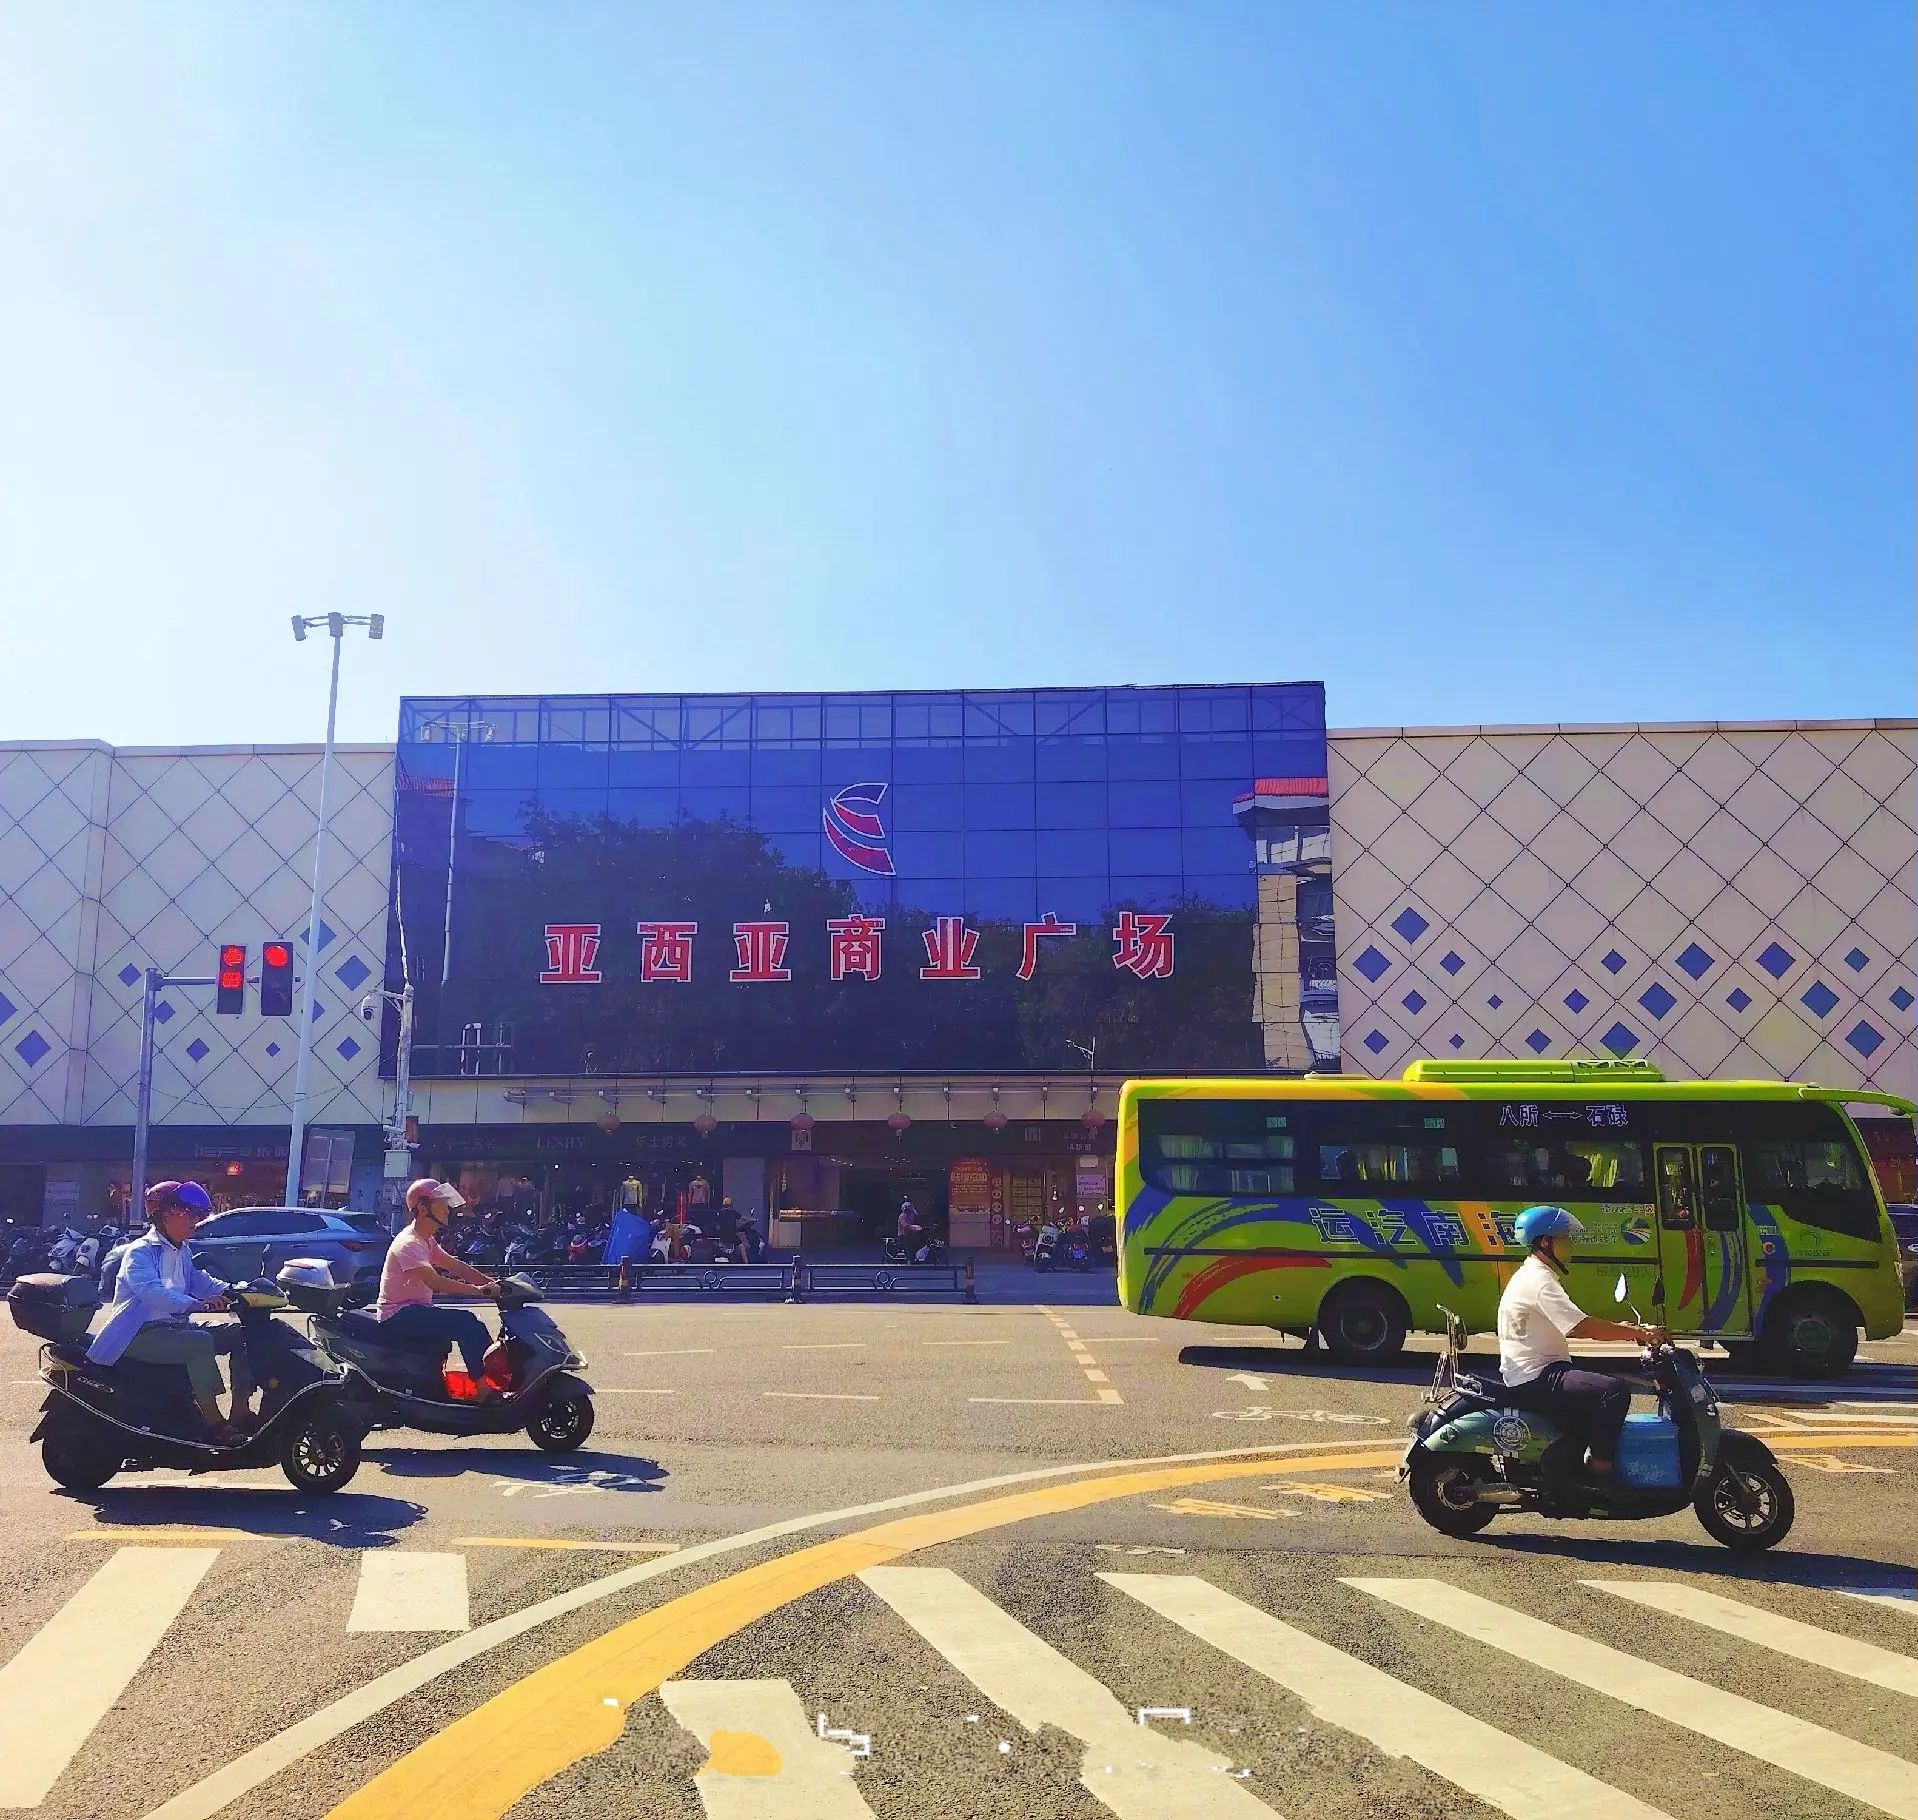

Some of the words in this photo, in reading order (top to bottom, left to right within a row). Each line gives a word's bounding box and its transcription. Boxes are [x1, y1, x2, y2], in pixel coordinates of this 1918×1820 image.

[540, 911, 1175, 984] 亚西亚商业广场
[1499, 1104, 1539, 1127] 八所
[1585, 1104, 1629, 1127] 石碌
